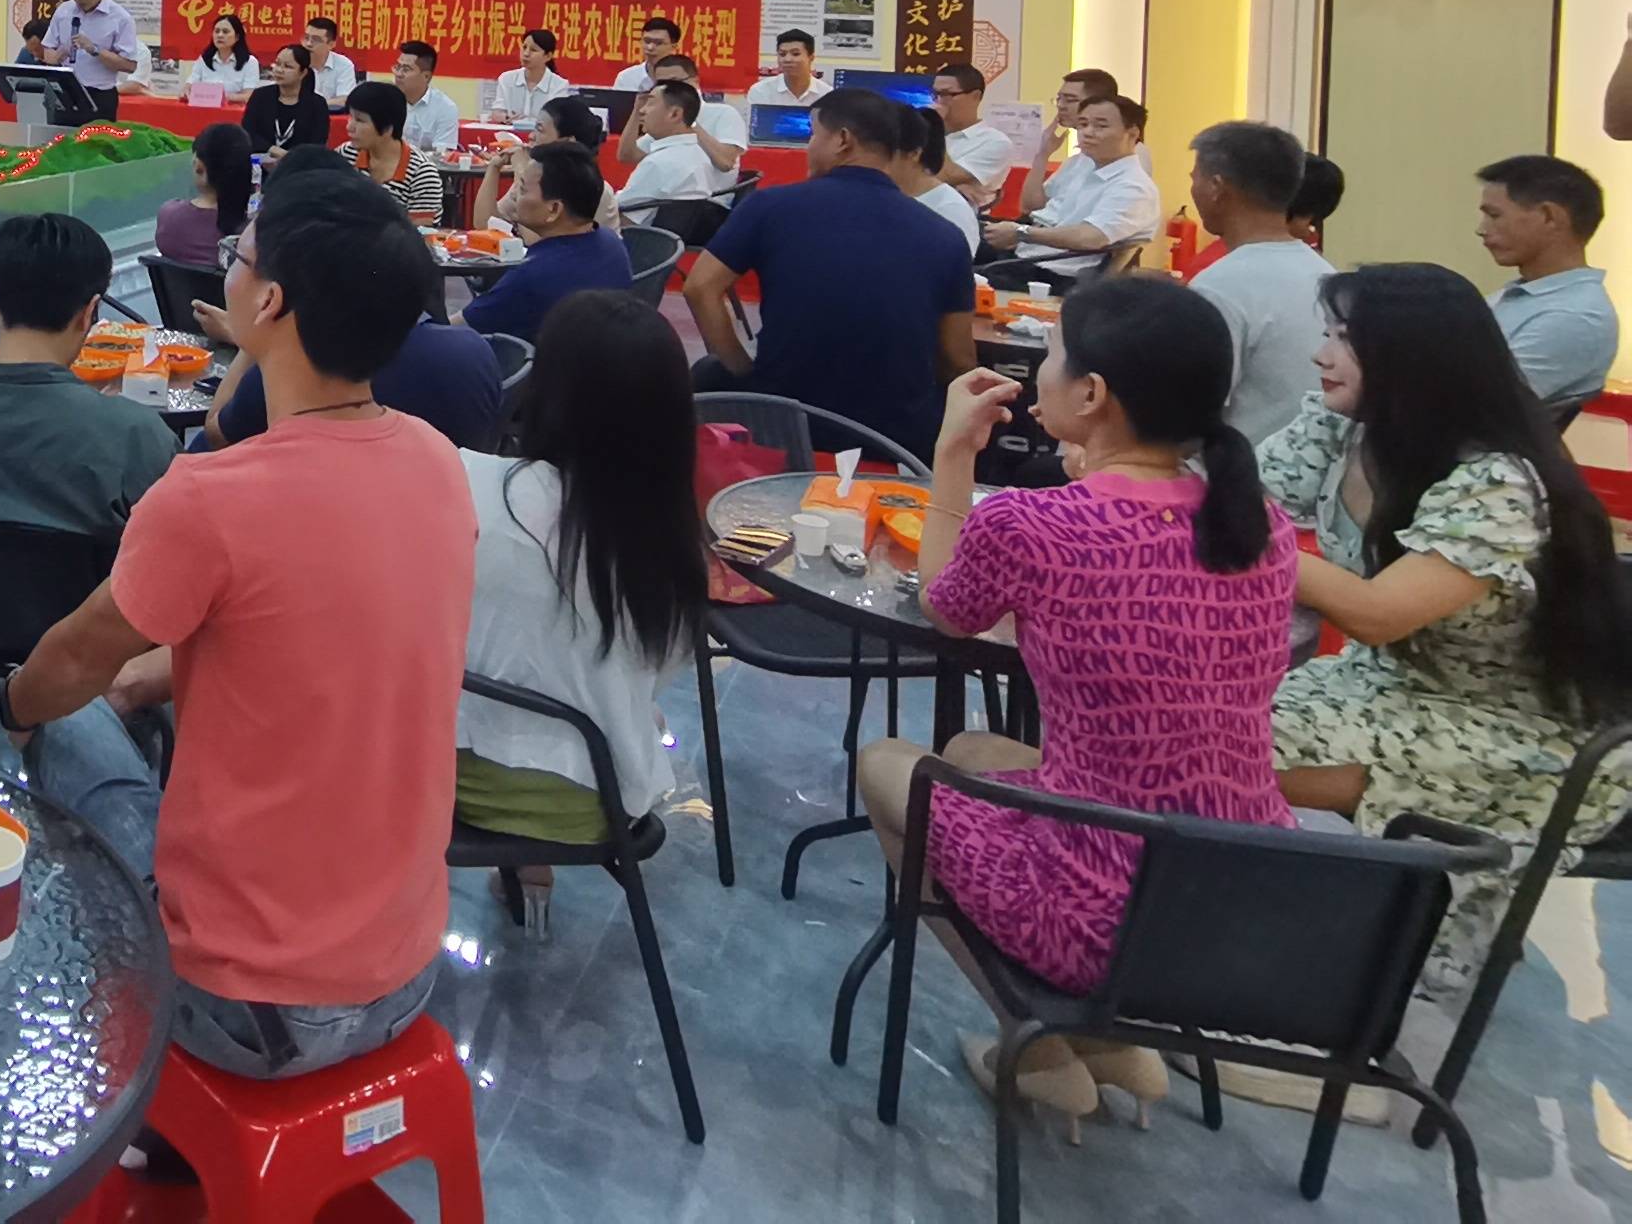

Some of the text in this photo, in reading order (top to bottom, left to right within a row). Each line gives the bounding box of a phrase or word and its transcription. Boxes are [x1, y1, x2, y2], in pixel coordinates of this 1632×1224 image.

[542, 1, 737, 67] 促进农业信化转型
